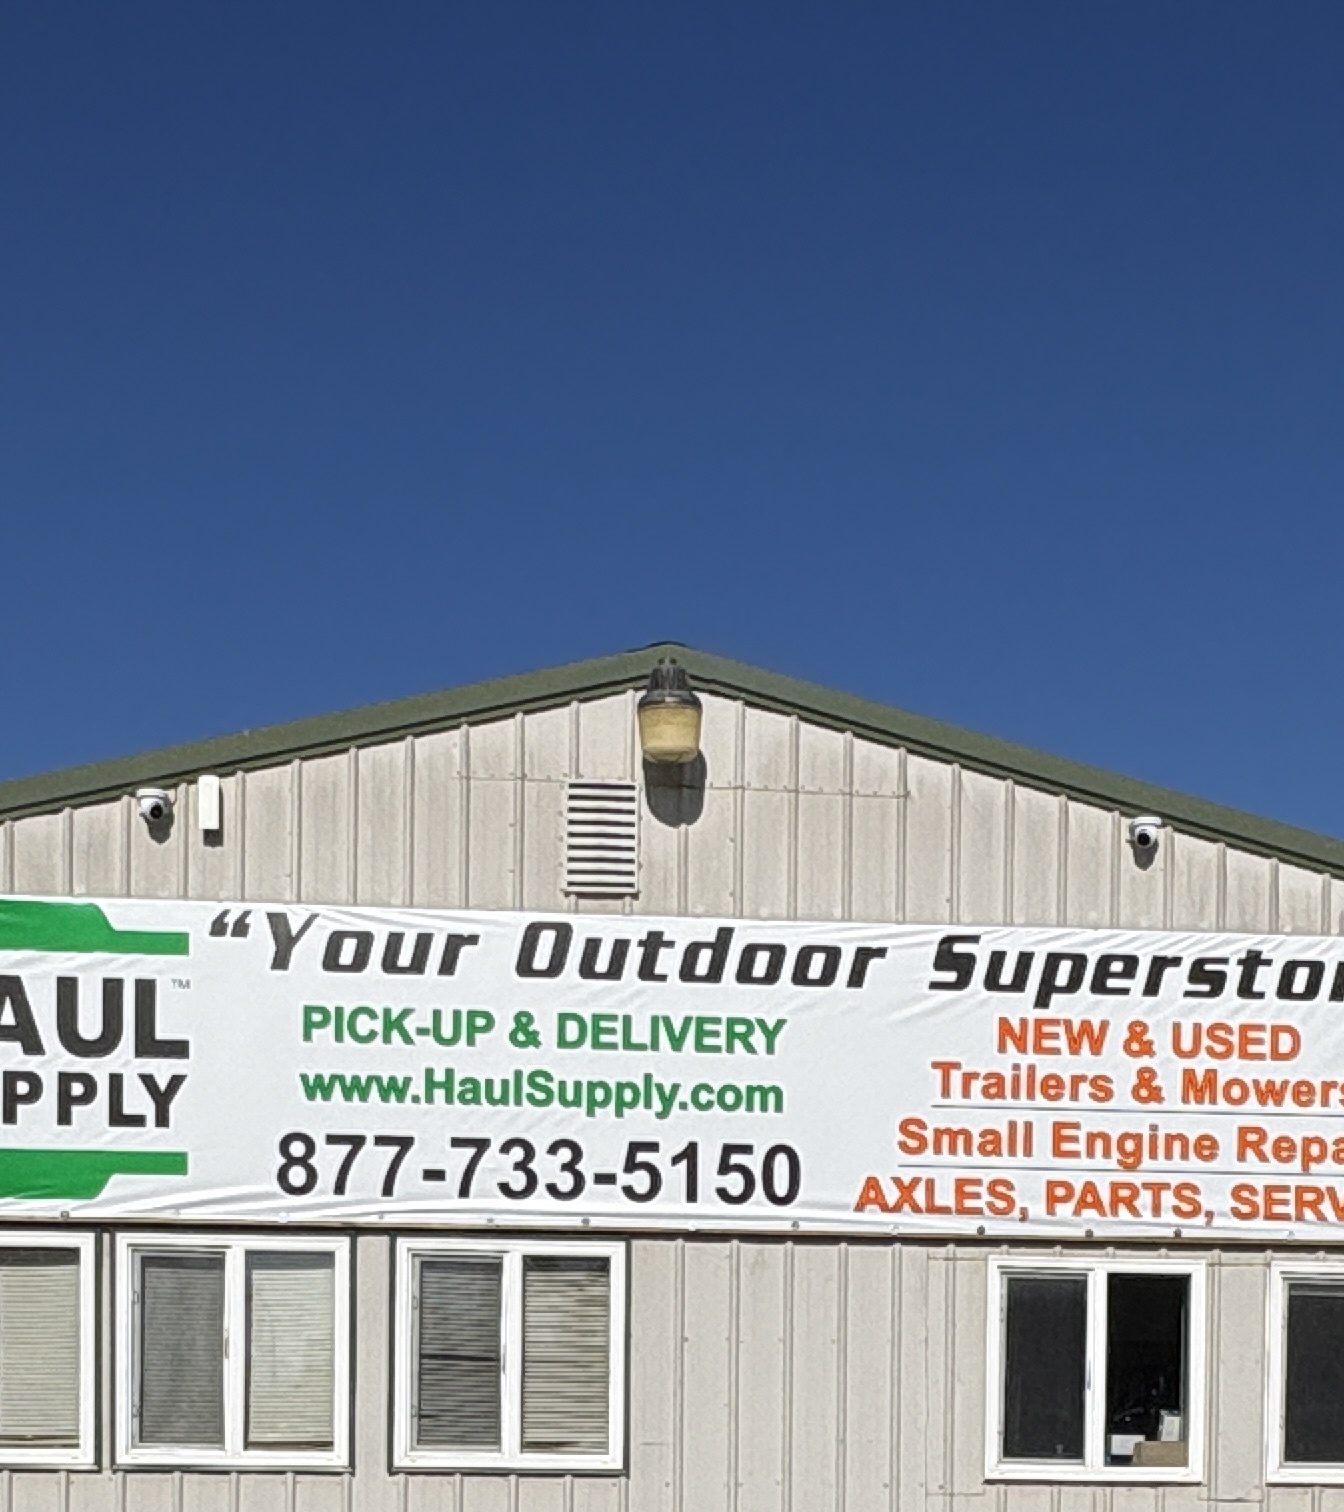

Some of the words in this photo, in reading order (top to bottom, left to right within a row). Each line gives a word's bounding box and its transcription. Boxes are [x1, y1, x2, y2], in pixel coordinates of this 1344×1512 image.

[515, 921, 888, 988] Outdoor
[302, 1005, 494, 1046] PICK-UP
[509, 1011, 541, 1048] &
[557, 1012, 784, 1053] DELIVERY
[997, 1016, 1109, 1056] NEW
[1122, 1019, 1156, 1059] &
[1171, 1022, 1302, 1062] USED
[301, 1069, 783, 1118] www.HaulSupply.com
[932, 1061, 1114, 1103] Trailers
[1130, 1065, 1165, 1105] &
[276, 1132, 801, 1206] 877-733-5150
[898, 1117, 1033, 1158] Small
[1051, 1121, 1220, 1171] Engine
[855, 1175, 1028, 1222] AXLES,
[1044, 1179, 1213, 1227] PARTS,
